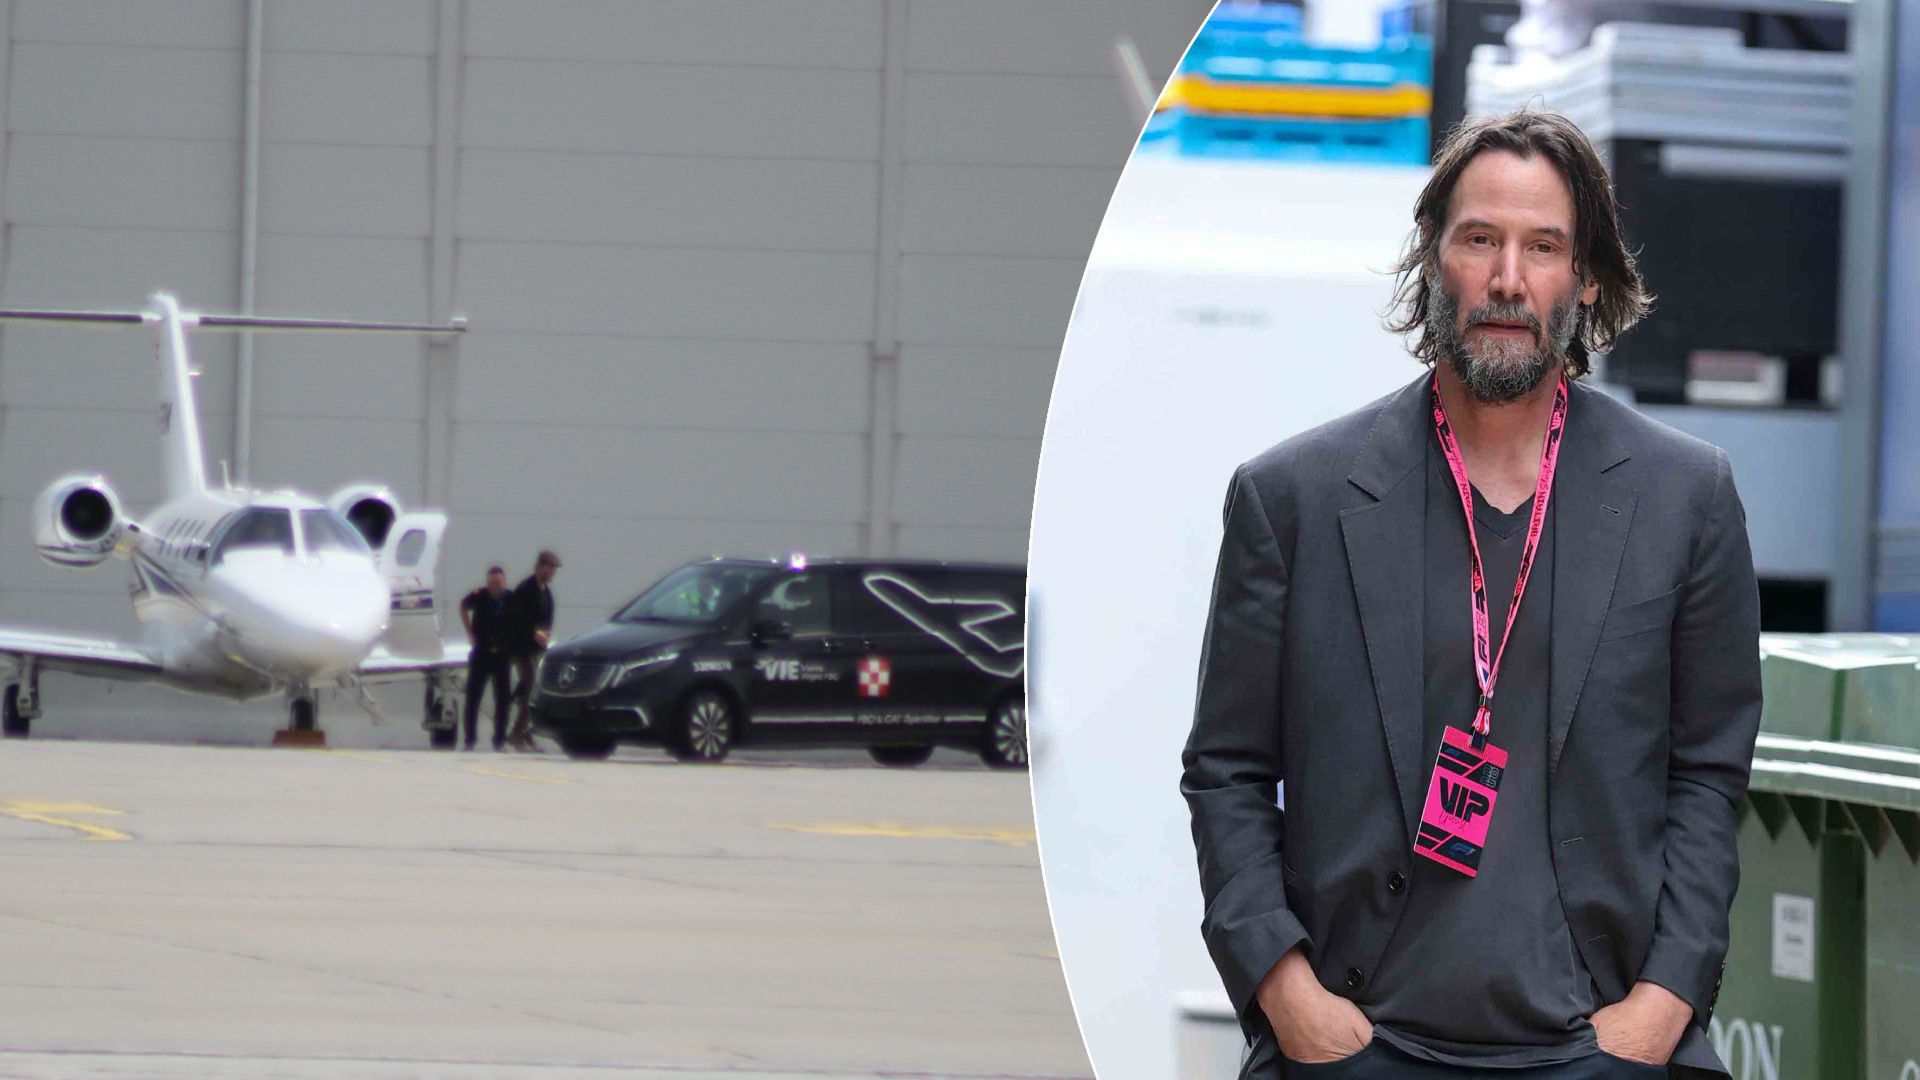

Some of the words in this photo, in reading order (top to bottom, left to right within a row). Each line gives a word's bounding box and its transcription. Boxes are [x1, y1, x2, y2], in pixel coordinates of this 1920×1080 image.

[1550, 411, 1562, 431] VIP
[1531, 491, 1546, 537] BRITAIN
[766, 660, 799, 681] VIE
[1439, 776, 1490, 822] VIP
